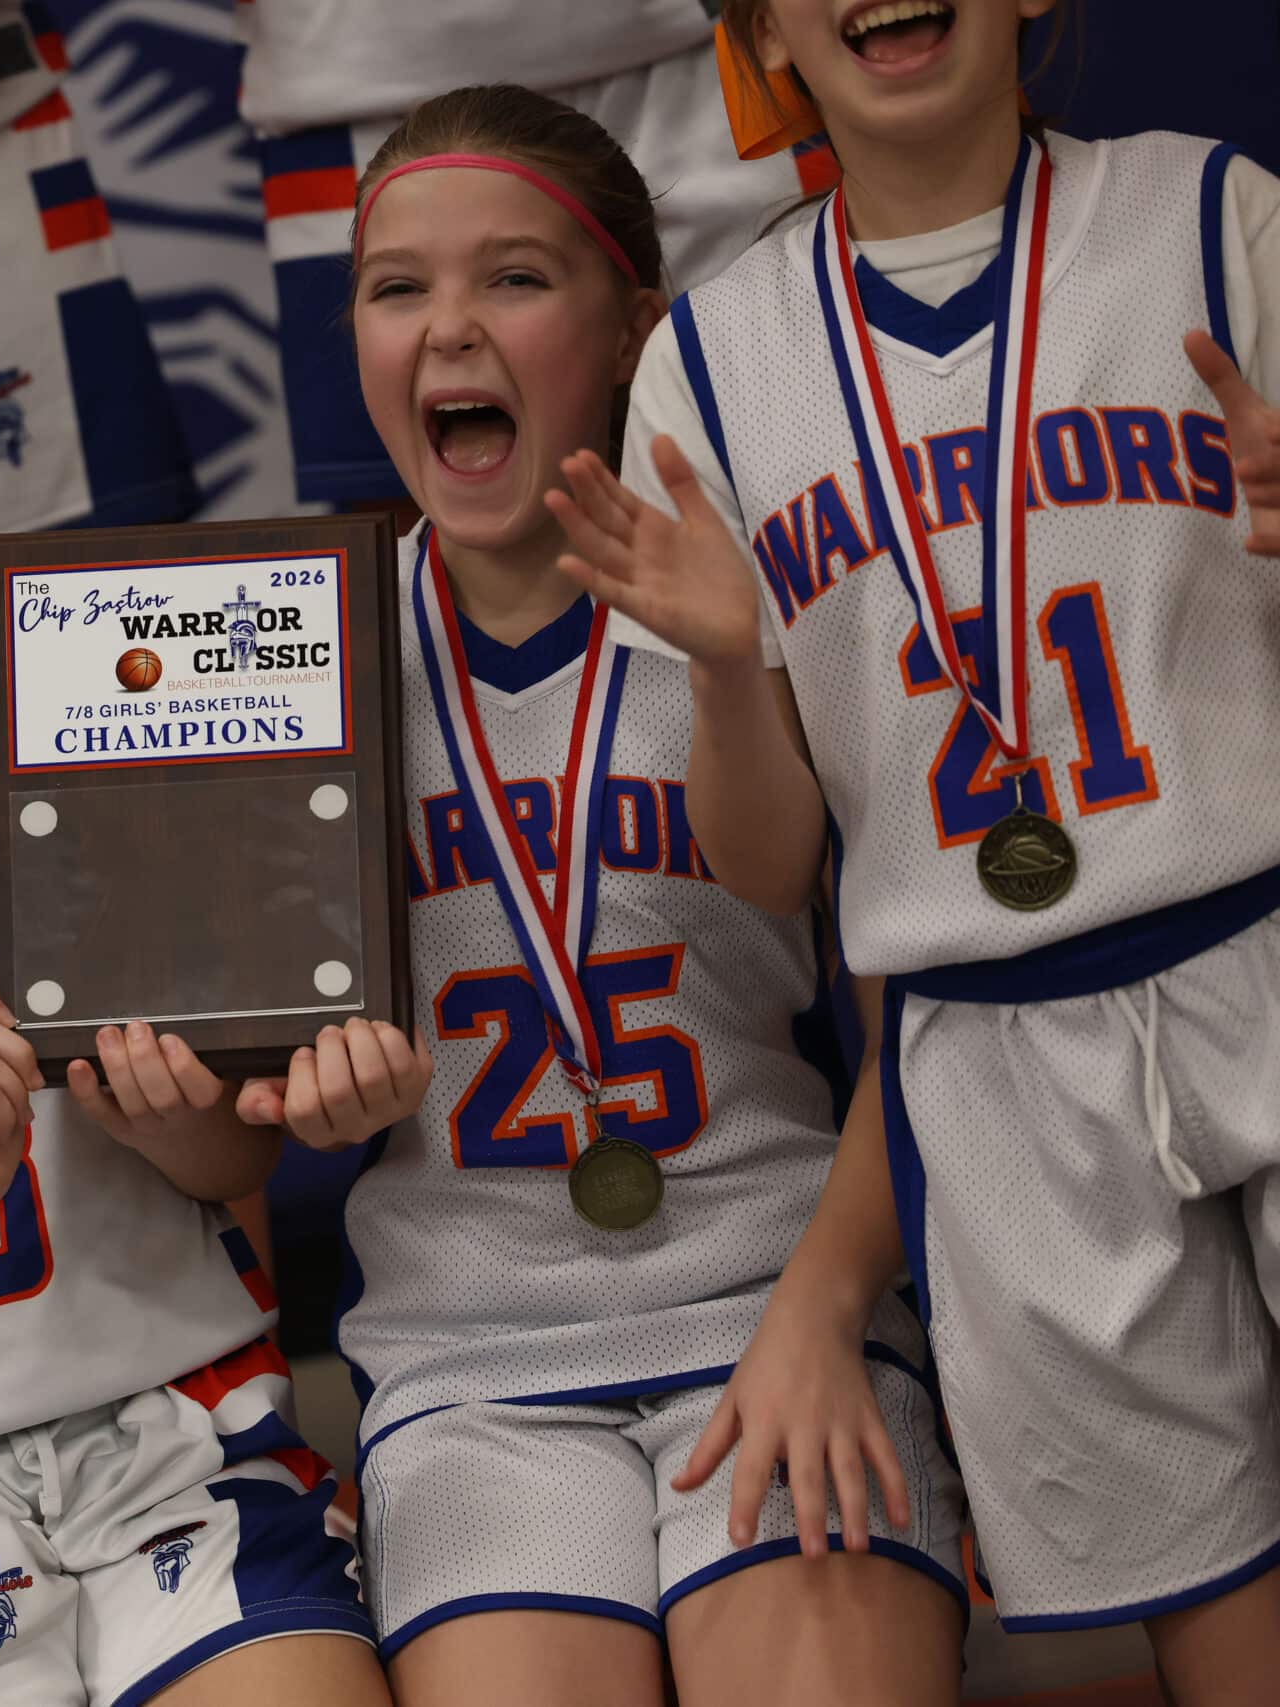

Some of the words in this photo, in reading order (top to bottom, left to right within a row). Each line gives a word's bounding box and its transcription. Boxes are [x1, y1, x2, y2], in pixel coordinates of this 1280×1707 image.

[751, 406, 1236, 630] WARORS
[16, 581, 50, 596] The
[270, 570, 326, 587] 2026
[18, 598, 76, 632] Chip
[83, 586, 175, 625] Zastrow
[167, 677, 246, 692] BASKETBALL
[246, 671, 333, 687] TOURNAMENT
[65, 705, 94, 720] 7/8
[169, 695, 293, 714] BASKETBALL
[898, 582, 1159, 849] 21
[54, 715, 304, 754] CHAMPIONS
[433, 942, 709, 1170] 25
